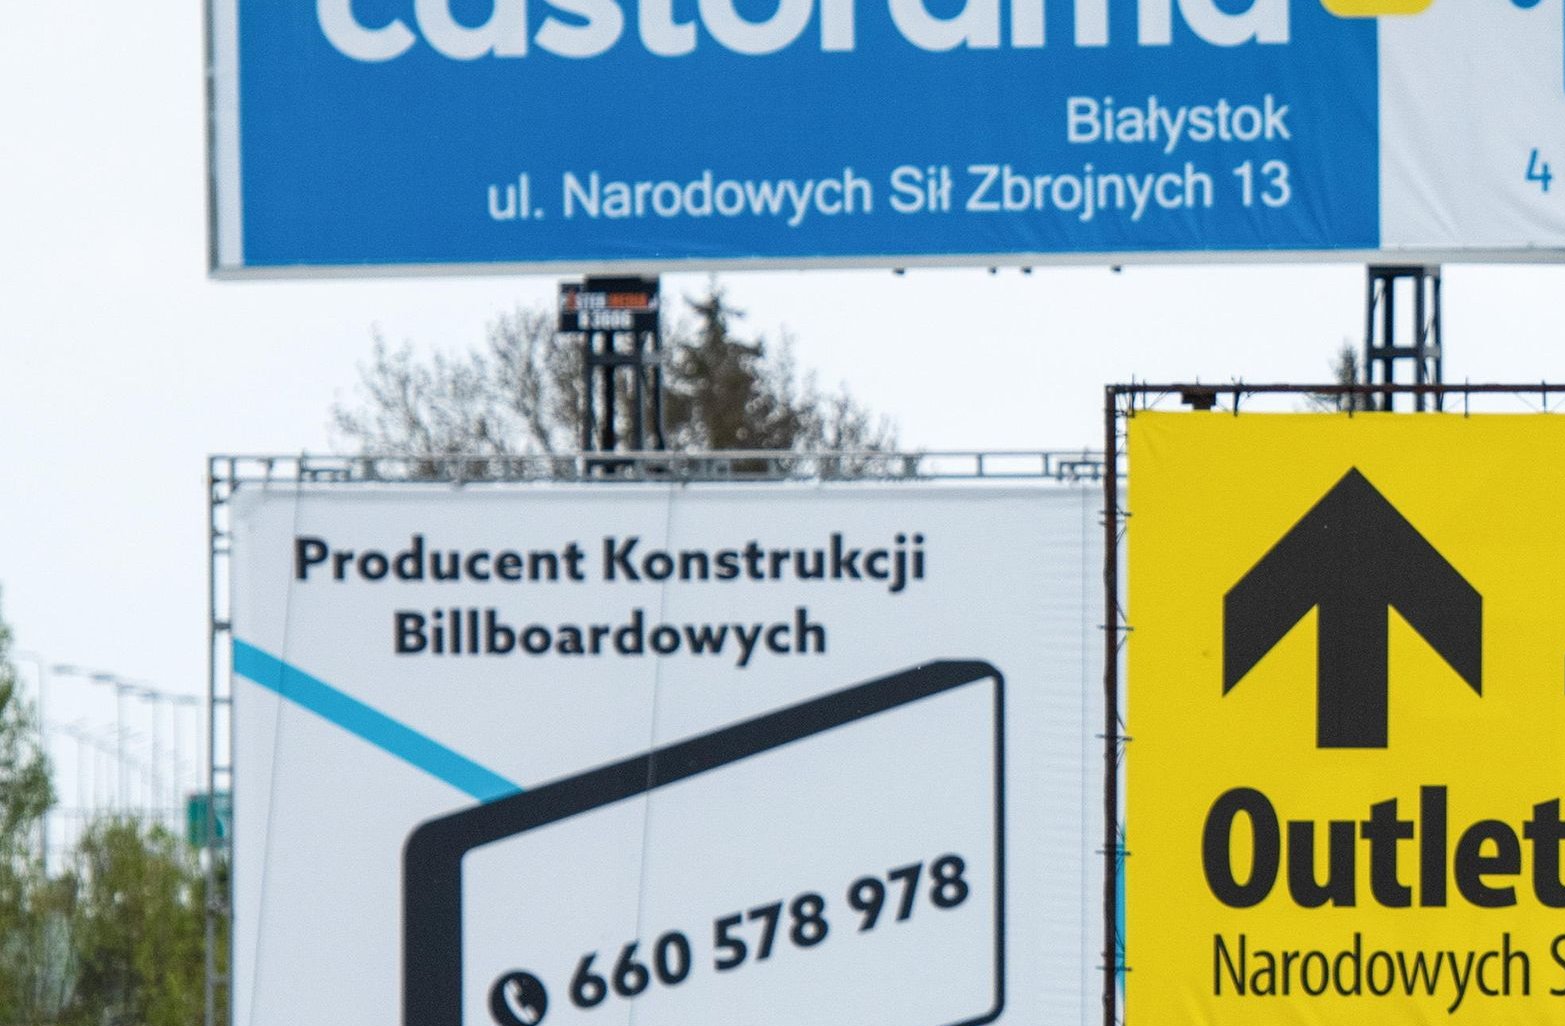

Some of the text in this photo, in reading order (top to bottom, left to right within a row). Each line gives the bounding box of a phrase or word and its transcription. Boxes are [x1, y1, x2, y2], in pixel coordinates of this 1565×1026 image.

[1067, 94, 1291, 154] Białystok
[488, 159, 1292, 227] ul. Narodowych Sił Zbrojnych 13
[1525, 148, 1554, 193] 4
[294, 532, 925, 594] Producent Konstrukcji
[394, 607, 826, 668] Billboardowych
[569, 853, 970, 1010] 660 578 978
[1213, 931, 1531, 1015] Narodowych
